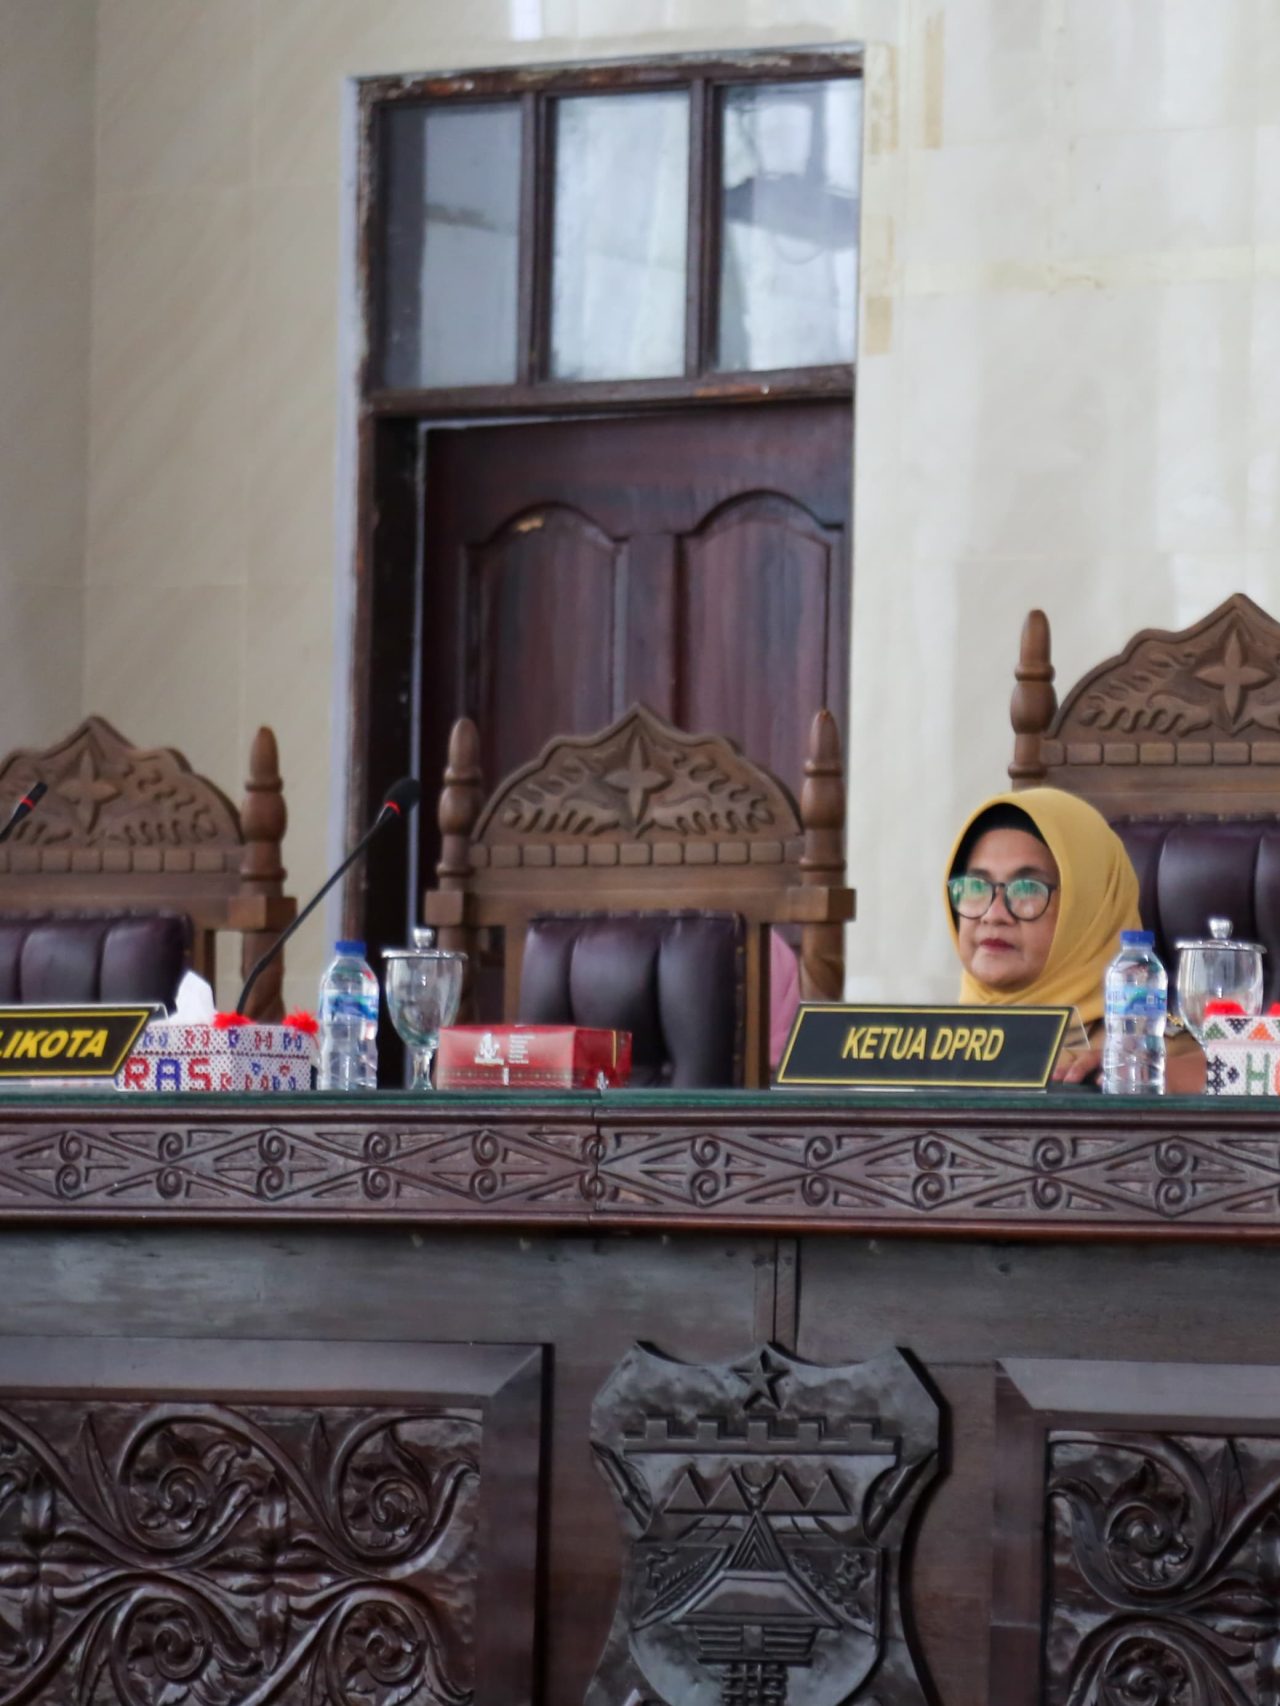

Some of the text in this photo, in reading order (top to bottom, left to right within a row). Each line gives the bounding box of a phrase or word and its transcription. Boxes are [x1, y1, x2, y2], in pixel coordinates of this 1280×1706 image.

[0, 1029, 108, 1058] IKOTA
[841, 1026, 1005, 1062] KETUA DPRD
[113, 1056, 212, 1091] RAS
